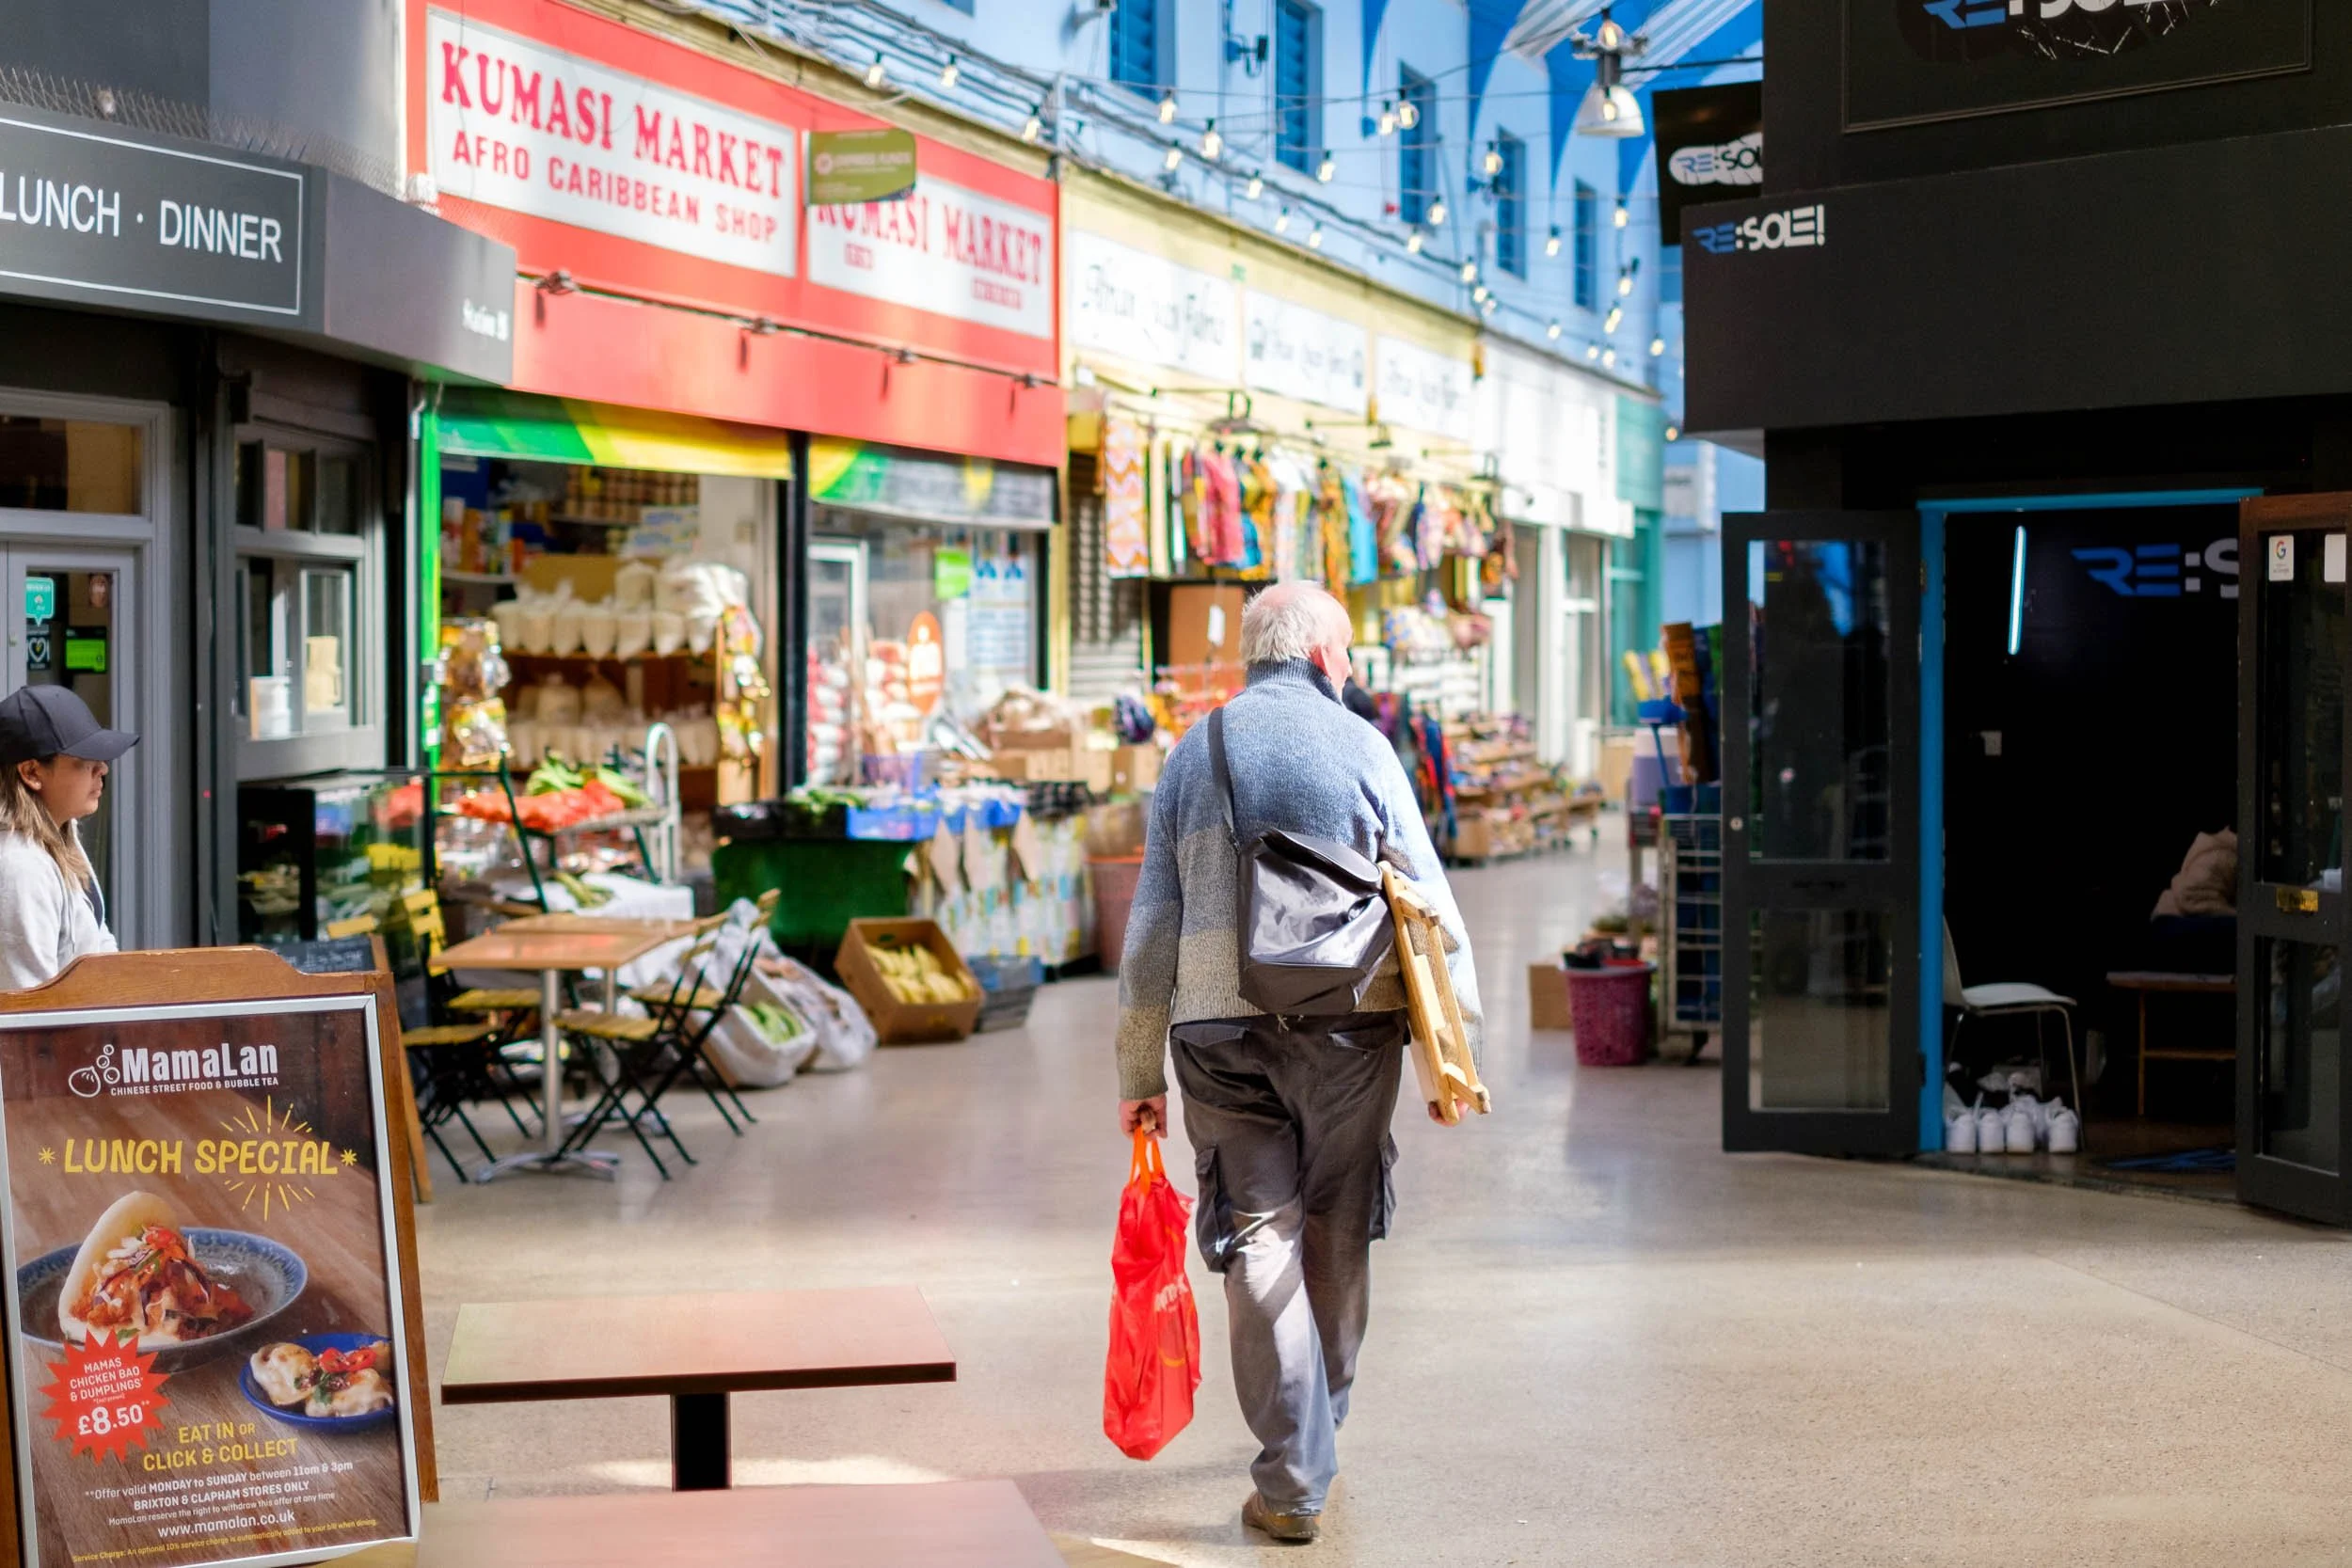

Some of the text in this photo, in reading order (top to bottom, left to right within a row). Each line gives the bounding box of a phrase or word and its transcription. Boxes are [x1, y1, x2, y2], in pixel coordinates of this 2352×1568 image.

[441, 40, 785, 199] KUMASI MARKET
[453, 129, 778, 243] AFRO CARIBBEAN SHOP
[0, 171, 282, 263] LUNCH DINNER
[942, 203, 1042, 286] MARKET
[121, 1042, 278, 1084] MamaLan
[110, 1077, 278, 1097] CHINESE STREET FOOD & BUBBLE TEA
[64, 1138, 339, 1175] LUNCH SPECIAL
[70, 1366, 140, 1389] CHICKEN BAO
[84, 1356, 122, 1374] MAMAS
[70, 1391, 77, 1402] &
[178, 1421, 256, 1444] EAT IN OR
[143, 1438, 298, 1471] CLICK & COLLECT
[121, 1483, 147, 1497] valid
[149, 1479, 193, 1493] MONDAY
[193, 1478, 204, 1487] to
[206, 1473, 247, 1487] SUNDAY
[249, 1468, 292, 1482] between
[294, 1465, 320, 1477] 11am
[322, 1464, 328, 1473] &
[330, 1461, 354, 1474] 3pm
[134, 1481, 310, 1511] BRIXTON & CLAPHAM STORES ONLY
[148, 1512, 177, 1522] reserve
[179, 1509, 192, 1517] the
[193, 1506, 211, 1518] right
[212, 1505, 221, 1513] to
[222, 1501, 257, 1513] withdraw
[258, 1498, 272, 1508] this
[274, 1496, 293, 1505] offer
[303, 1494, 317, 1503] any
[318, 1492, 335, 1500] time
[158, 1509, 295, 1538] www.mamalan.co.uk
